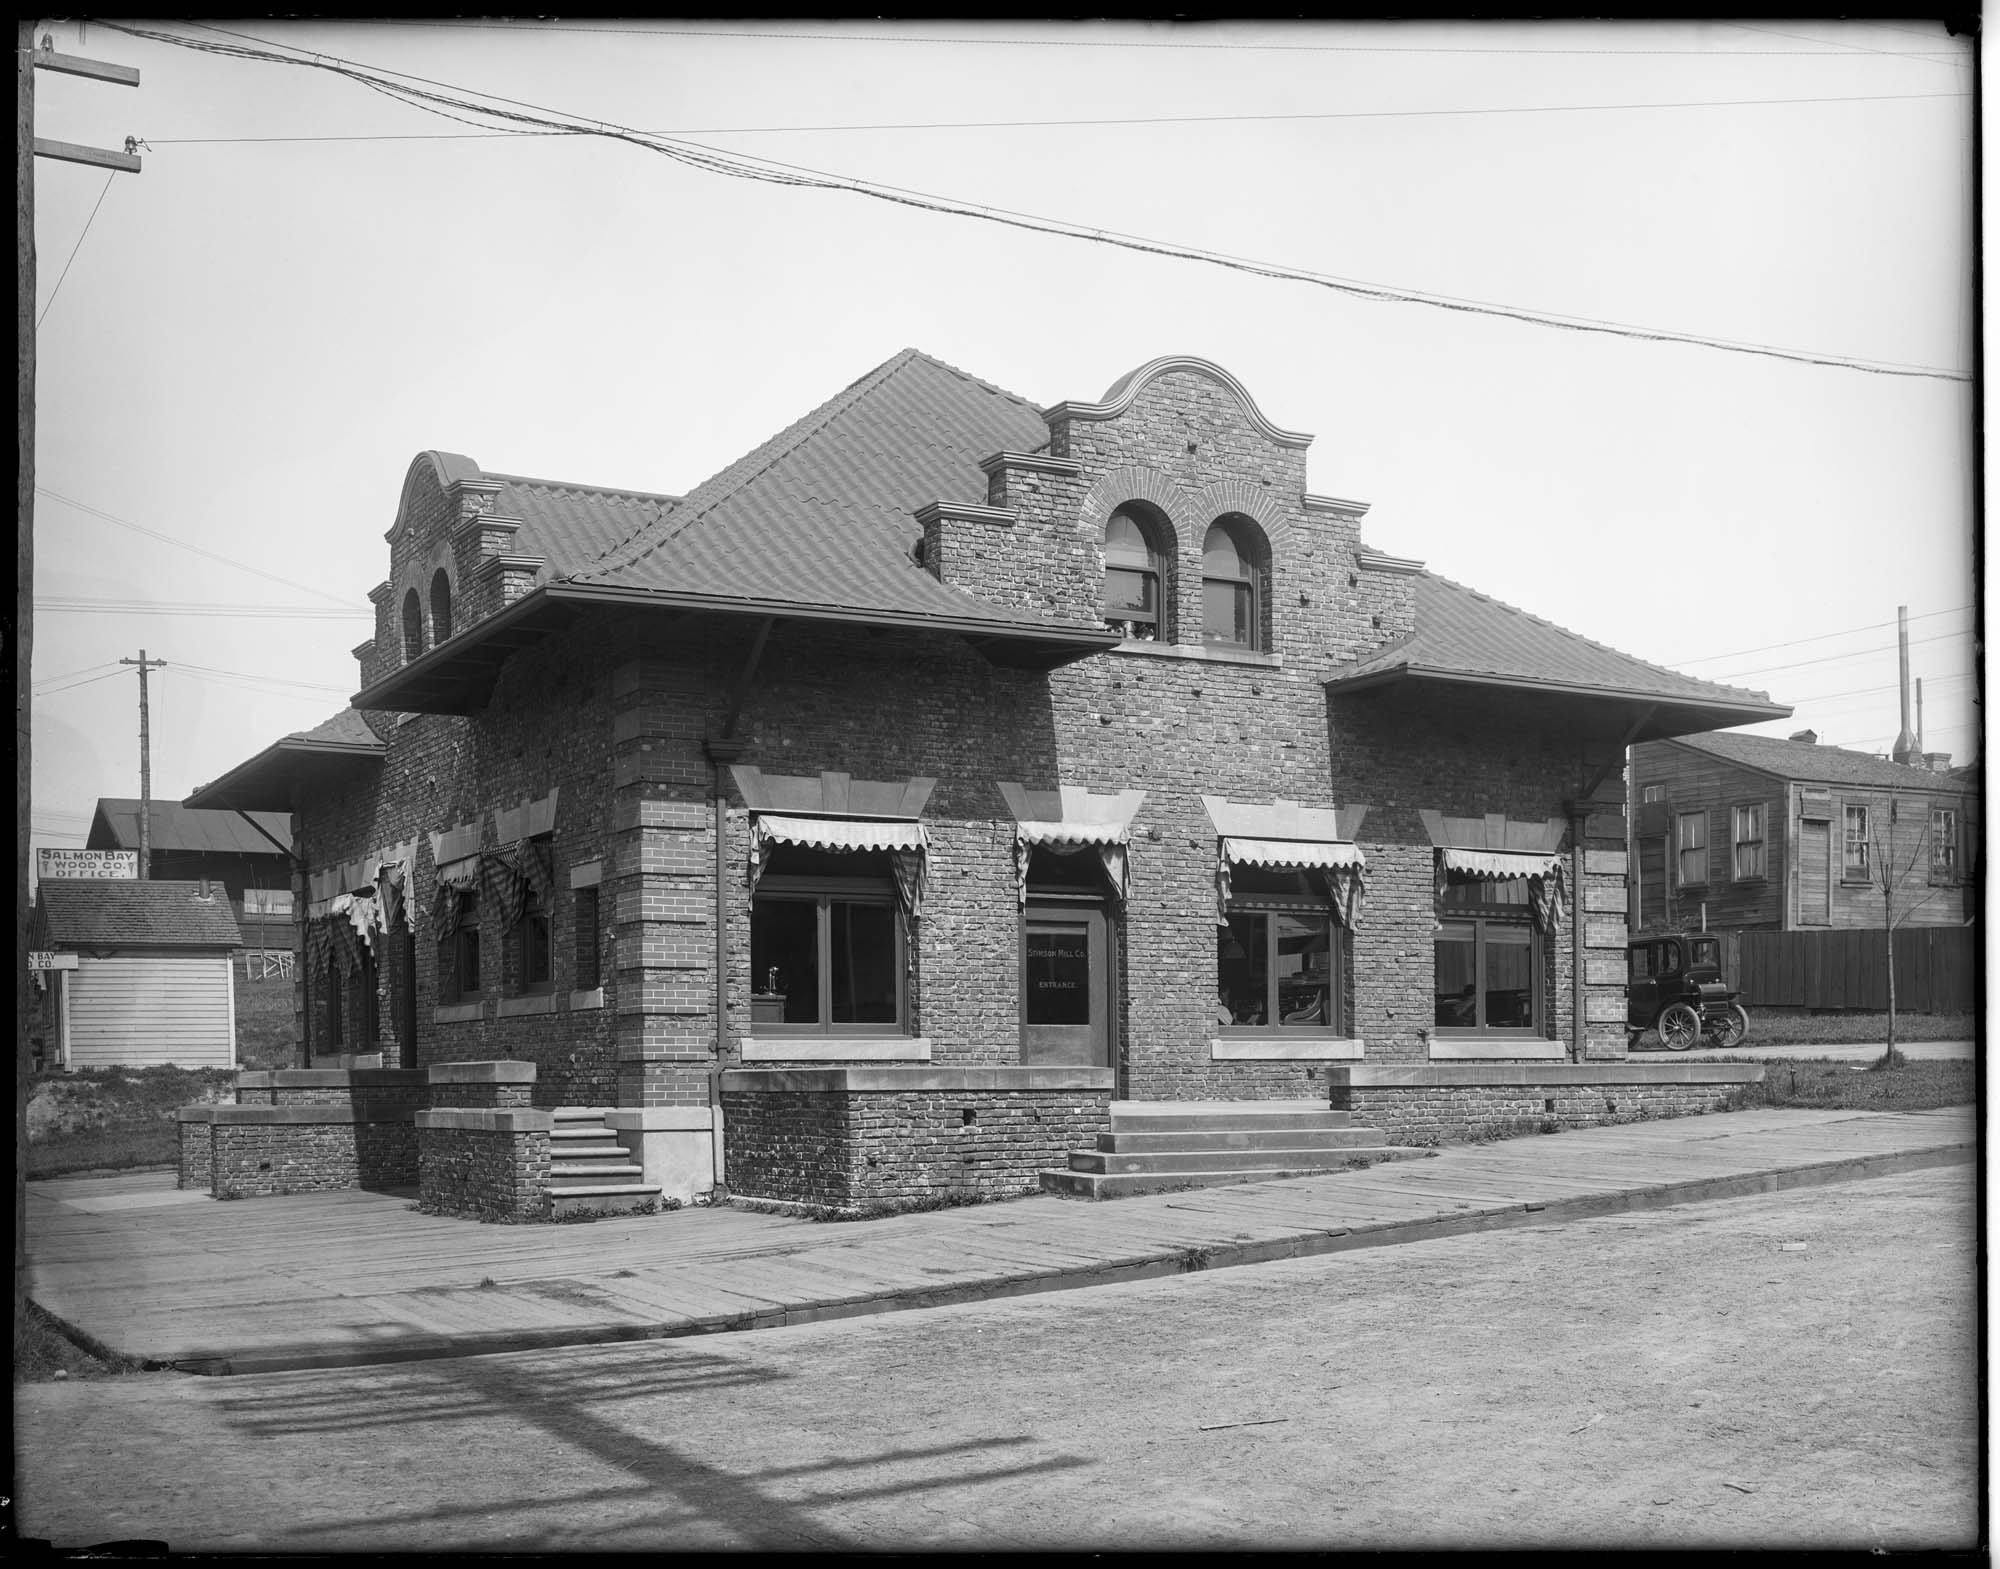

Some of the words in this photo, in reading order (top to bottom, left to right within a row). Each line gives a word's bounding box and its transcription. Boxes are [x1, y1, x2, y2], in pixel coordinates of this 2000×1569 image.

[41, 849, 102, 860] SALMON
[104, 850, 133, 860] BAY
[54, 861, 97, 869] WOOD
[102, 862, 126, 870] CO.
[55, 870, 125, 878] OFFICE.
[37, 952, 55, 961] BAY
